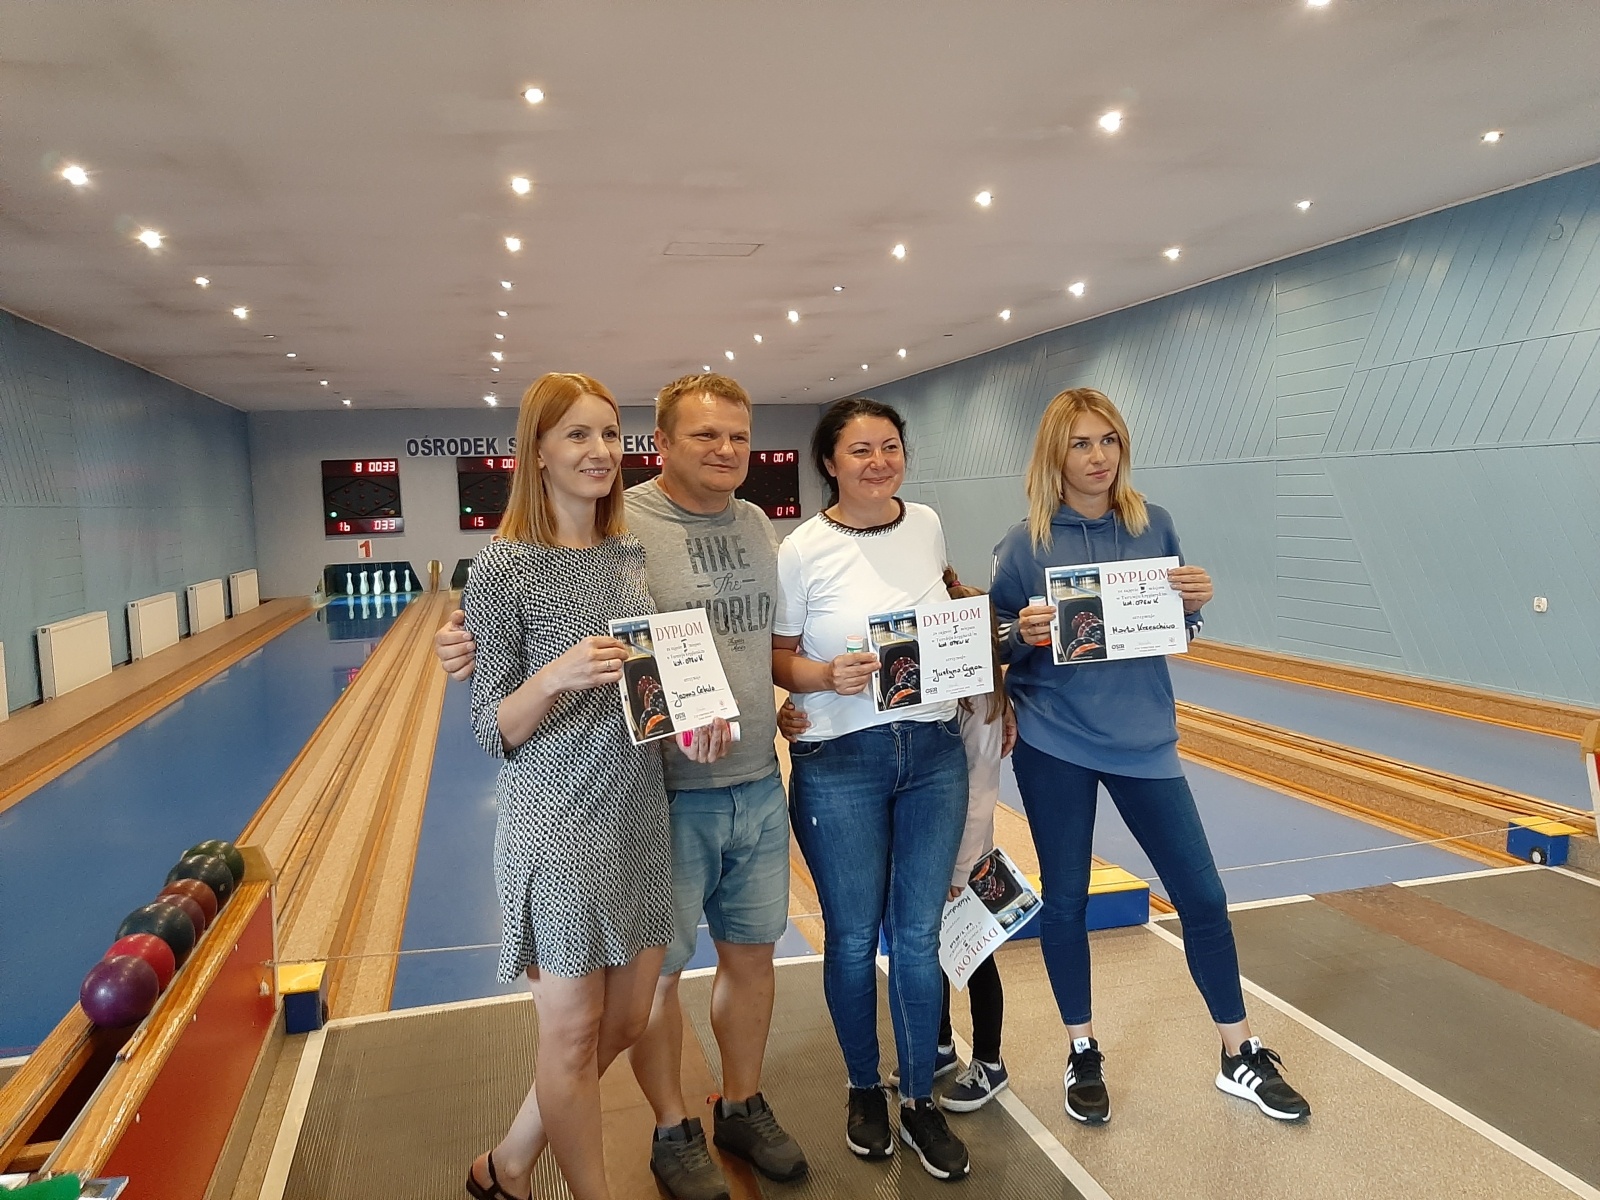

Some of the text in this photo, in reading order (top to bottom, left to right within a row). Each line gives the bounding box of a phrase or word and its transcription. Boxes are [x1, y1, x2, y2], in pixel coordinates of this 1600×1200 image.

[406, 435, 499, 456] OŚRODEK
[487, 459, 494, 469] 9
[643, 455, 649, 466] 7
[760, 452, 794, 463] 9 0019
[354, 461, 396, 473] 8 0033
[776, 506, 795, 517] 019
[373, 519, 396, 531] 033
[473, 516, 485, 527] 15
[359, 540, 371, 558] 1
[685, 535, 751, 574] HIKE
[713, 572, 742, 596] The
[1106, 569, 1169, 585] DYPLOM
[922, 607, 982, 628] DYPLOM
[655, 621, 705, 642] DYPLOM
[932, 668, 961, 683] Justyna
[954, 927, 999, 978] DYPLOM
